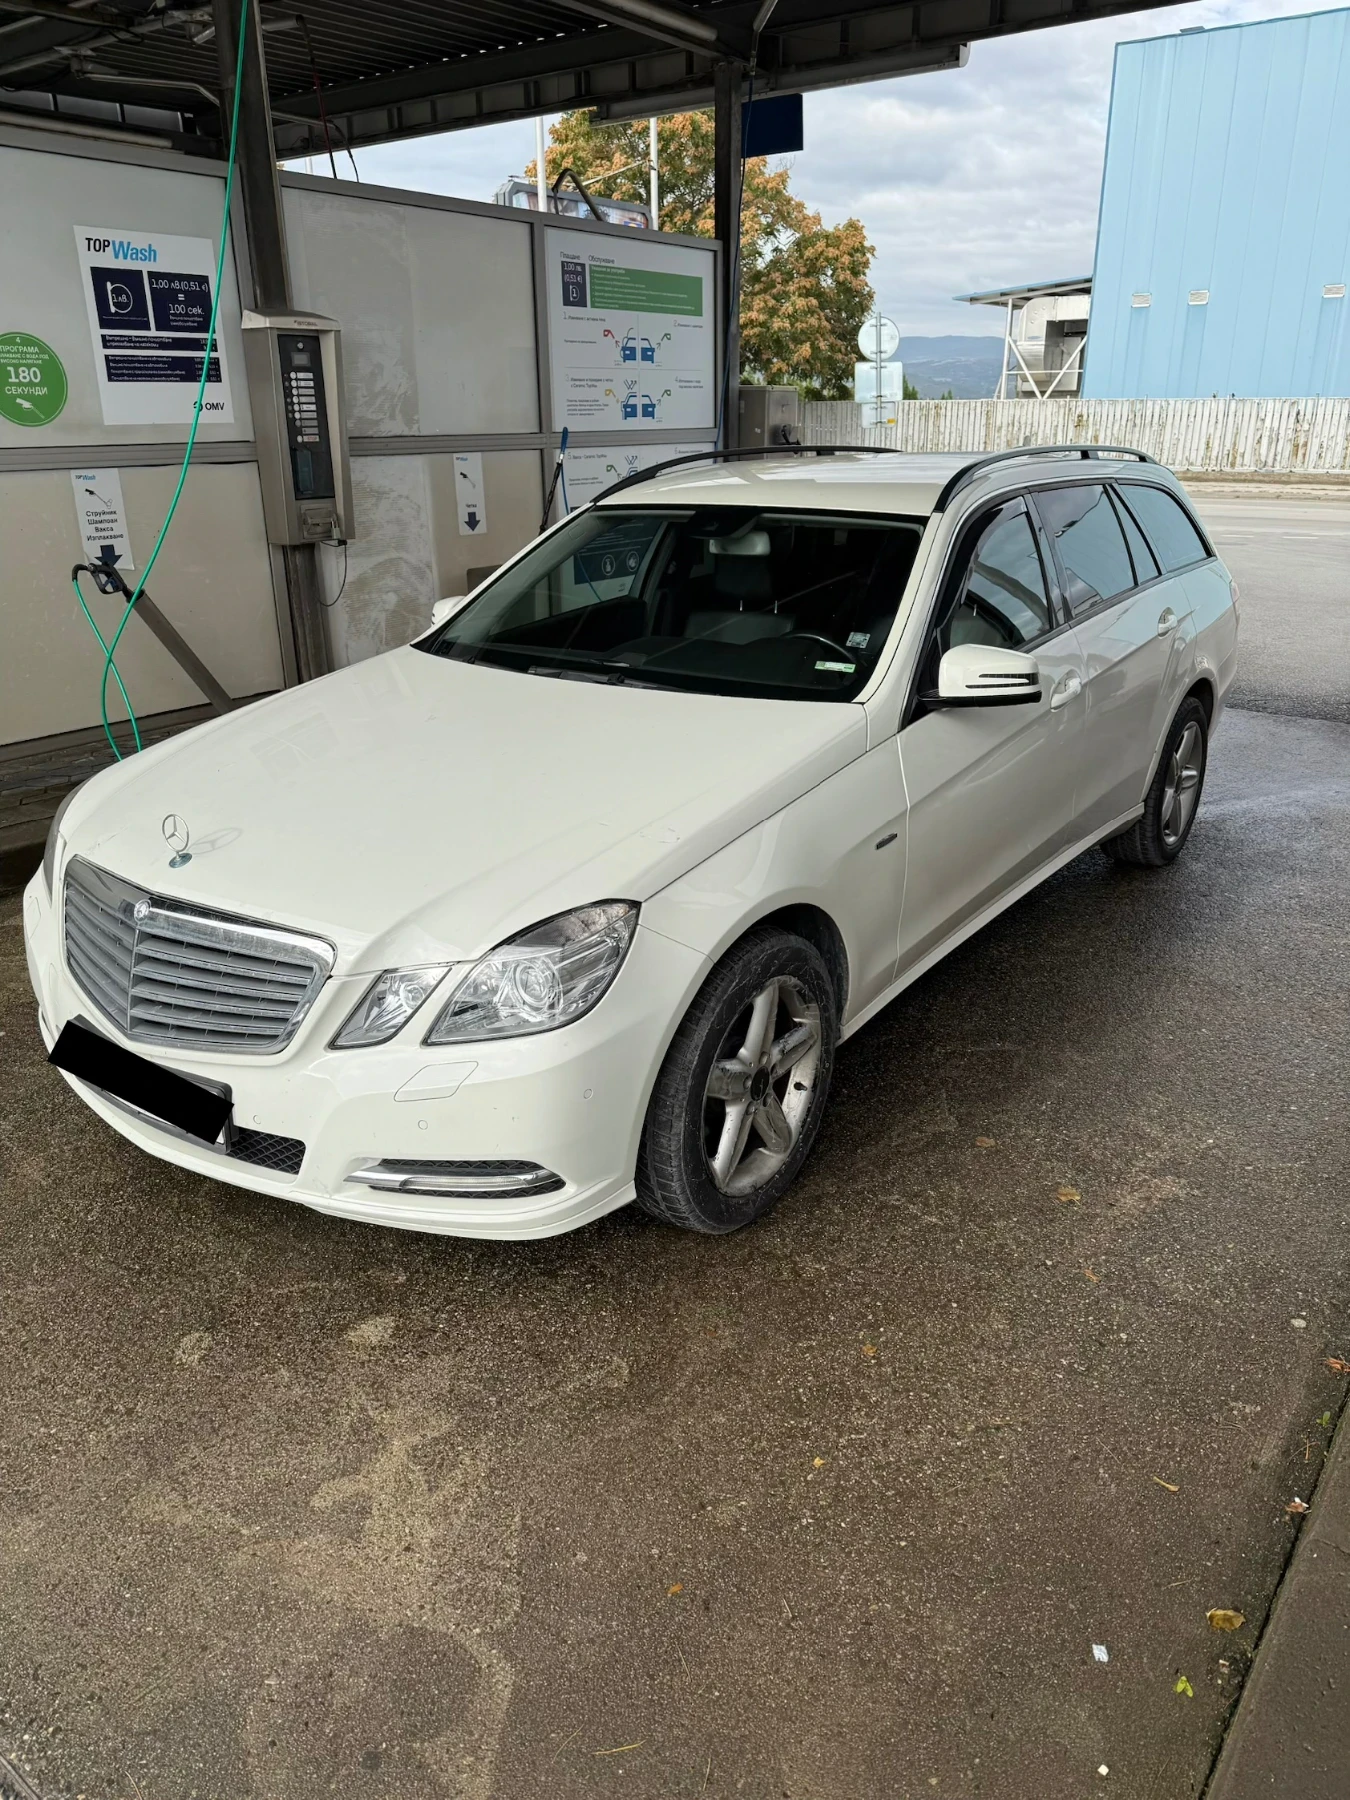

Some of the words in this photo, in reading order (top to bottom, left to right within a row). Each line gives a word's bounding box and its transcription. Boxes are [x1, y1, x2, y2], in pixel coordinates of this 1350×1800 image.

[151, 279, 169, 289] 1,00
[571, 288, 577, 297] 1
[169, 304, 186, 314] 100
[0, 345, 40, 353] ПРОГРАМА
[6, 366, 41, 383] 180
[5, 386, 48, 396] СЕКУНДИ
[205, 402, 225, 411] OMV
[88, 517, 118, 525] Шампоан
[87, 533, 124, 541] Изплакване
